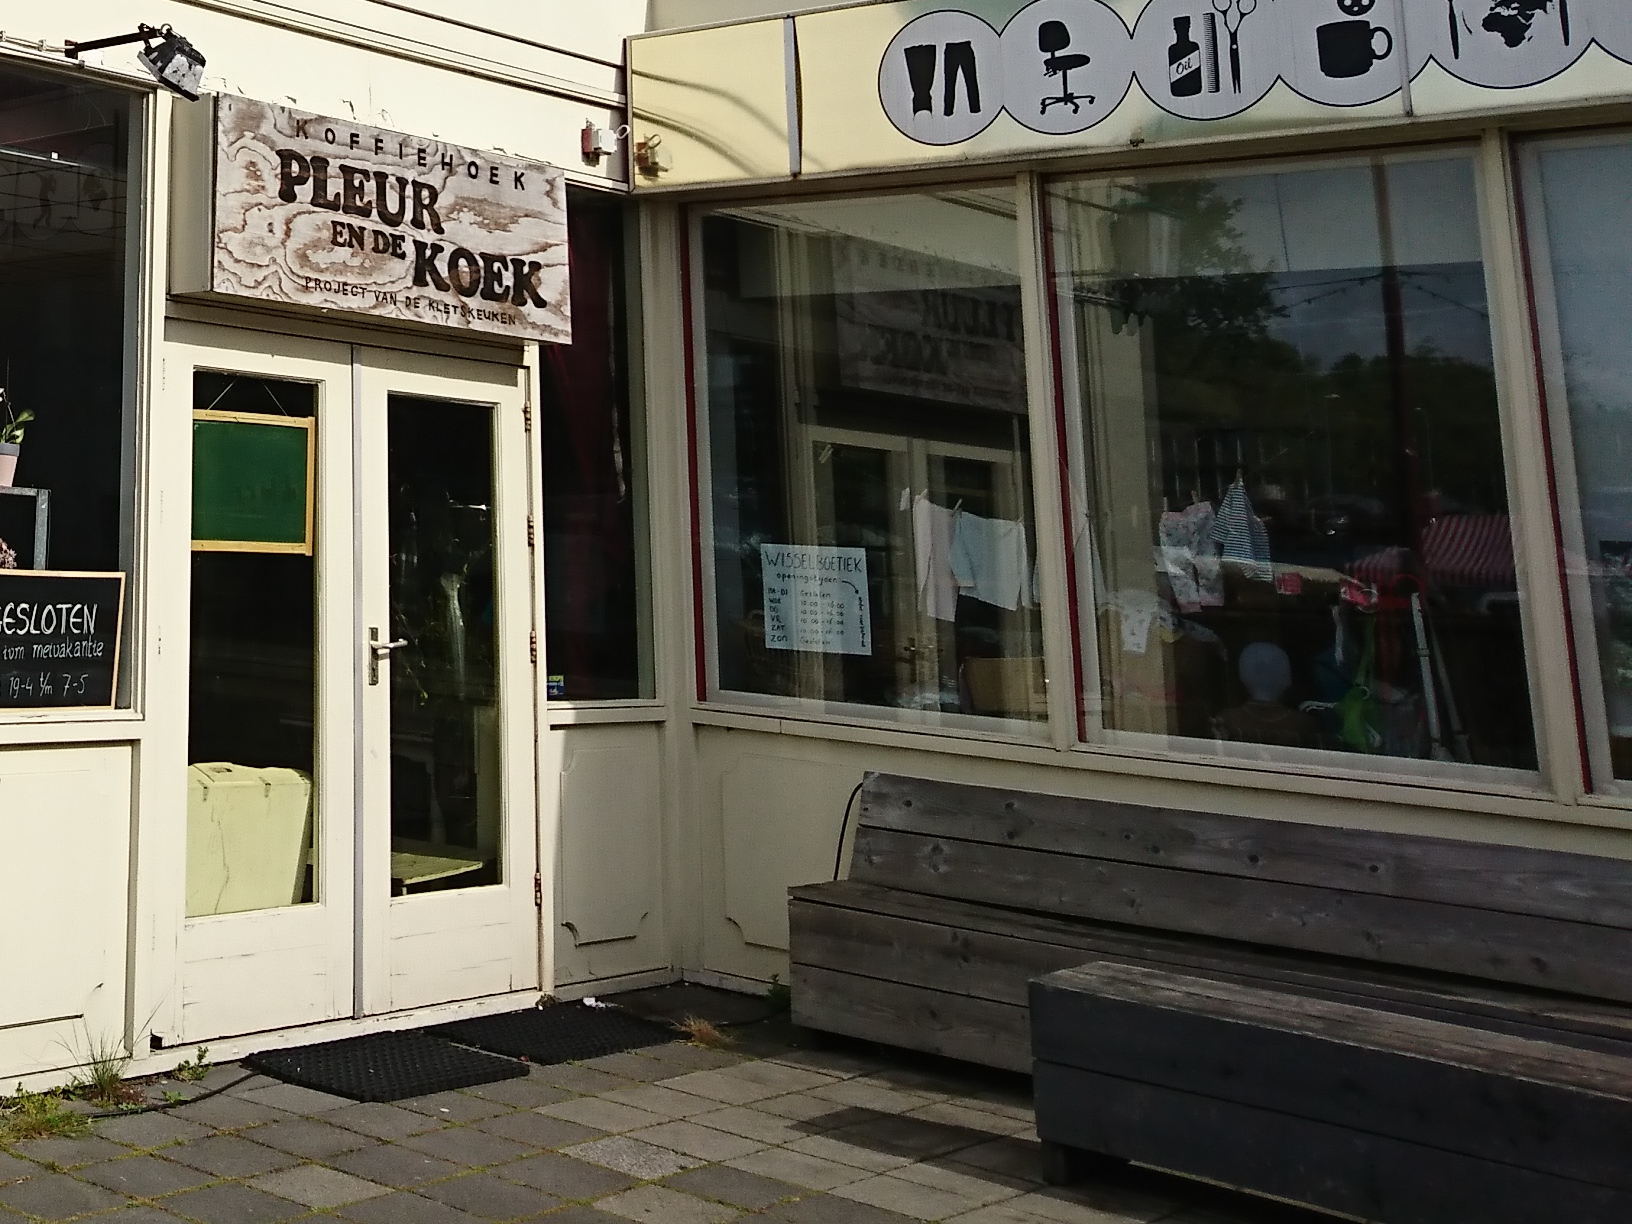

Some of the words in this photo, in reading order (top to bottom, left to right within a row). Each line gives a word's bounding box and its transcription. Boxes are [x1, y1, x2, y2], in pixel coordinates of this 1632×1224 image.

[1176, 57, 1193, 75] Oil
[295, 119, 527, 191] KOFFIEHOEK
[275, 148, 445, 235] PLEUR
[331, 220, 366, 253] EN
[372, 229, 407, 260] DE
[413, 238, 548, 309] KOEK
[304, 276, 368, 299] PROJECT
[374, 290, 397, 307] VAN
[405, 296, 421, 309] DE
[428, 299, 517, 326] KLETSKEUKEN
[32, 635, 104, 658] meivakantie
[9, 676, 33, 698] 19-4
[62, 673, 89, 697] 7-5
